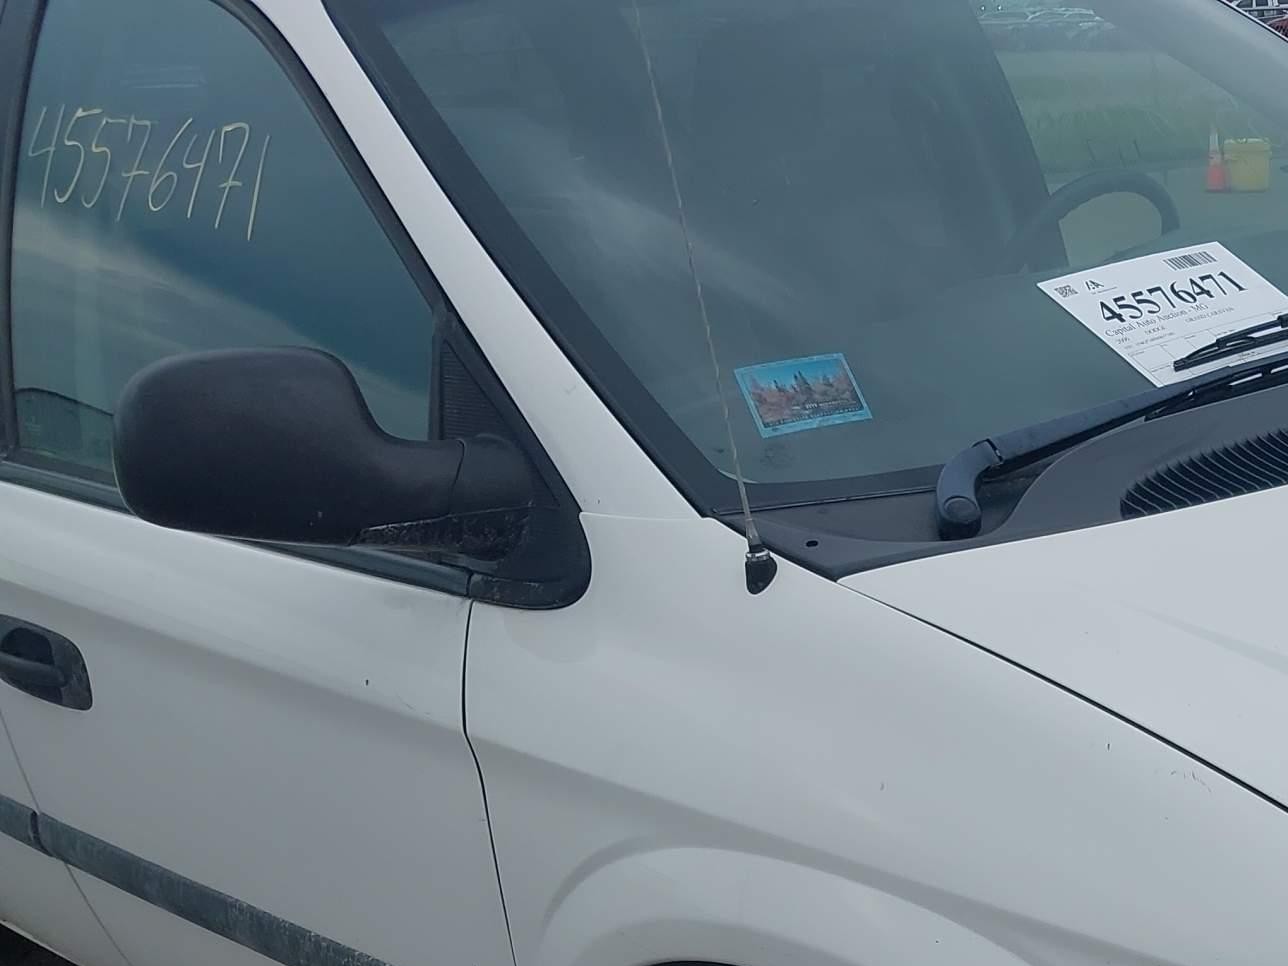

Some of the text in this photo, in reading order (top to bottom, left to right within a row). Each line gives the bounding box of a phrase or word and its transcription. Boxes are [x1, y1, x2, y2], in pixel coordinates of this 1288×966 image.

[28, 104, 271, 241] 45576471
[1099, 271, 1248, 323] 45576471
[1105, 322, 1136, 338] Capital
[1138, 318, 1157, 330] Auto
